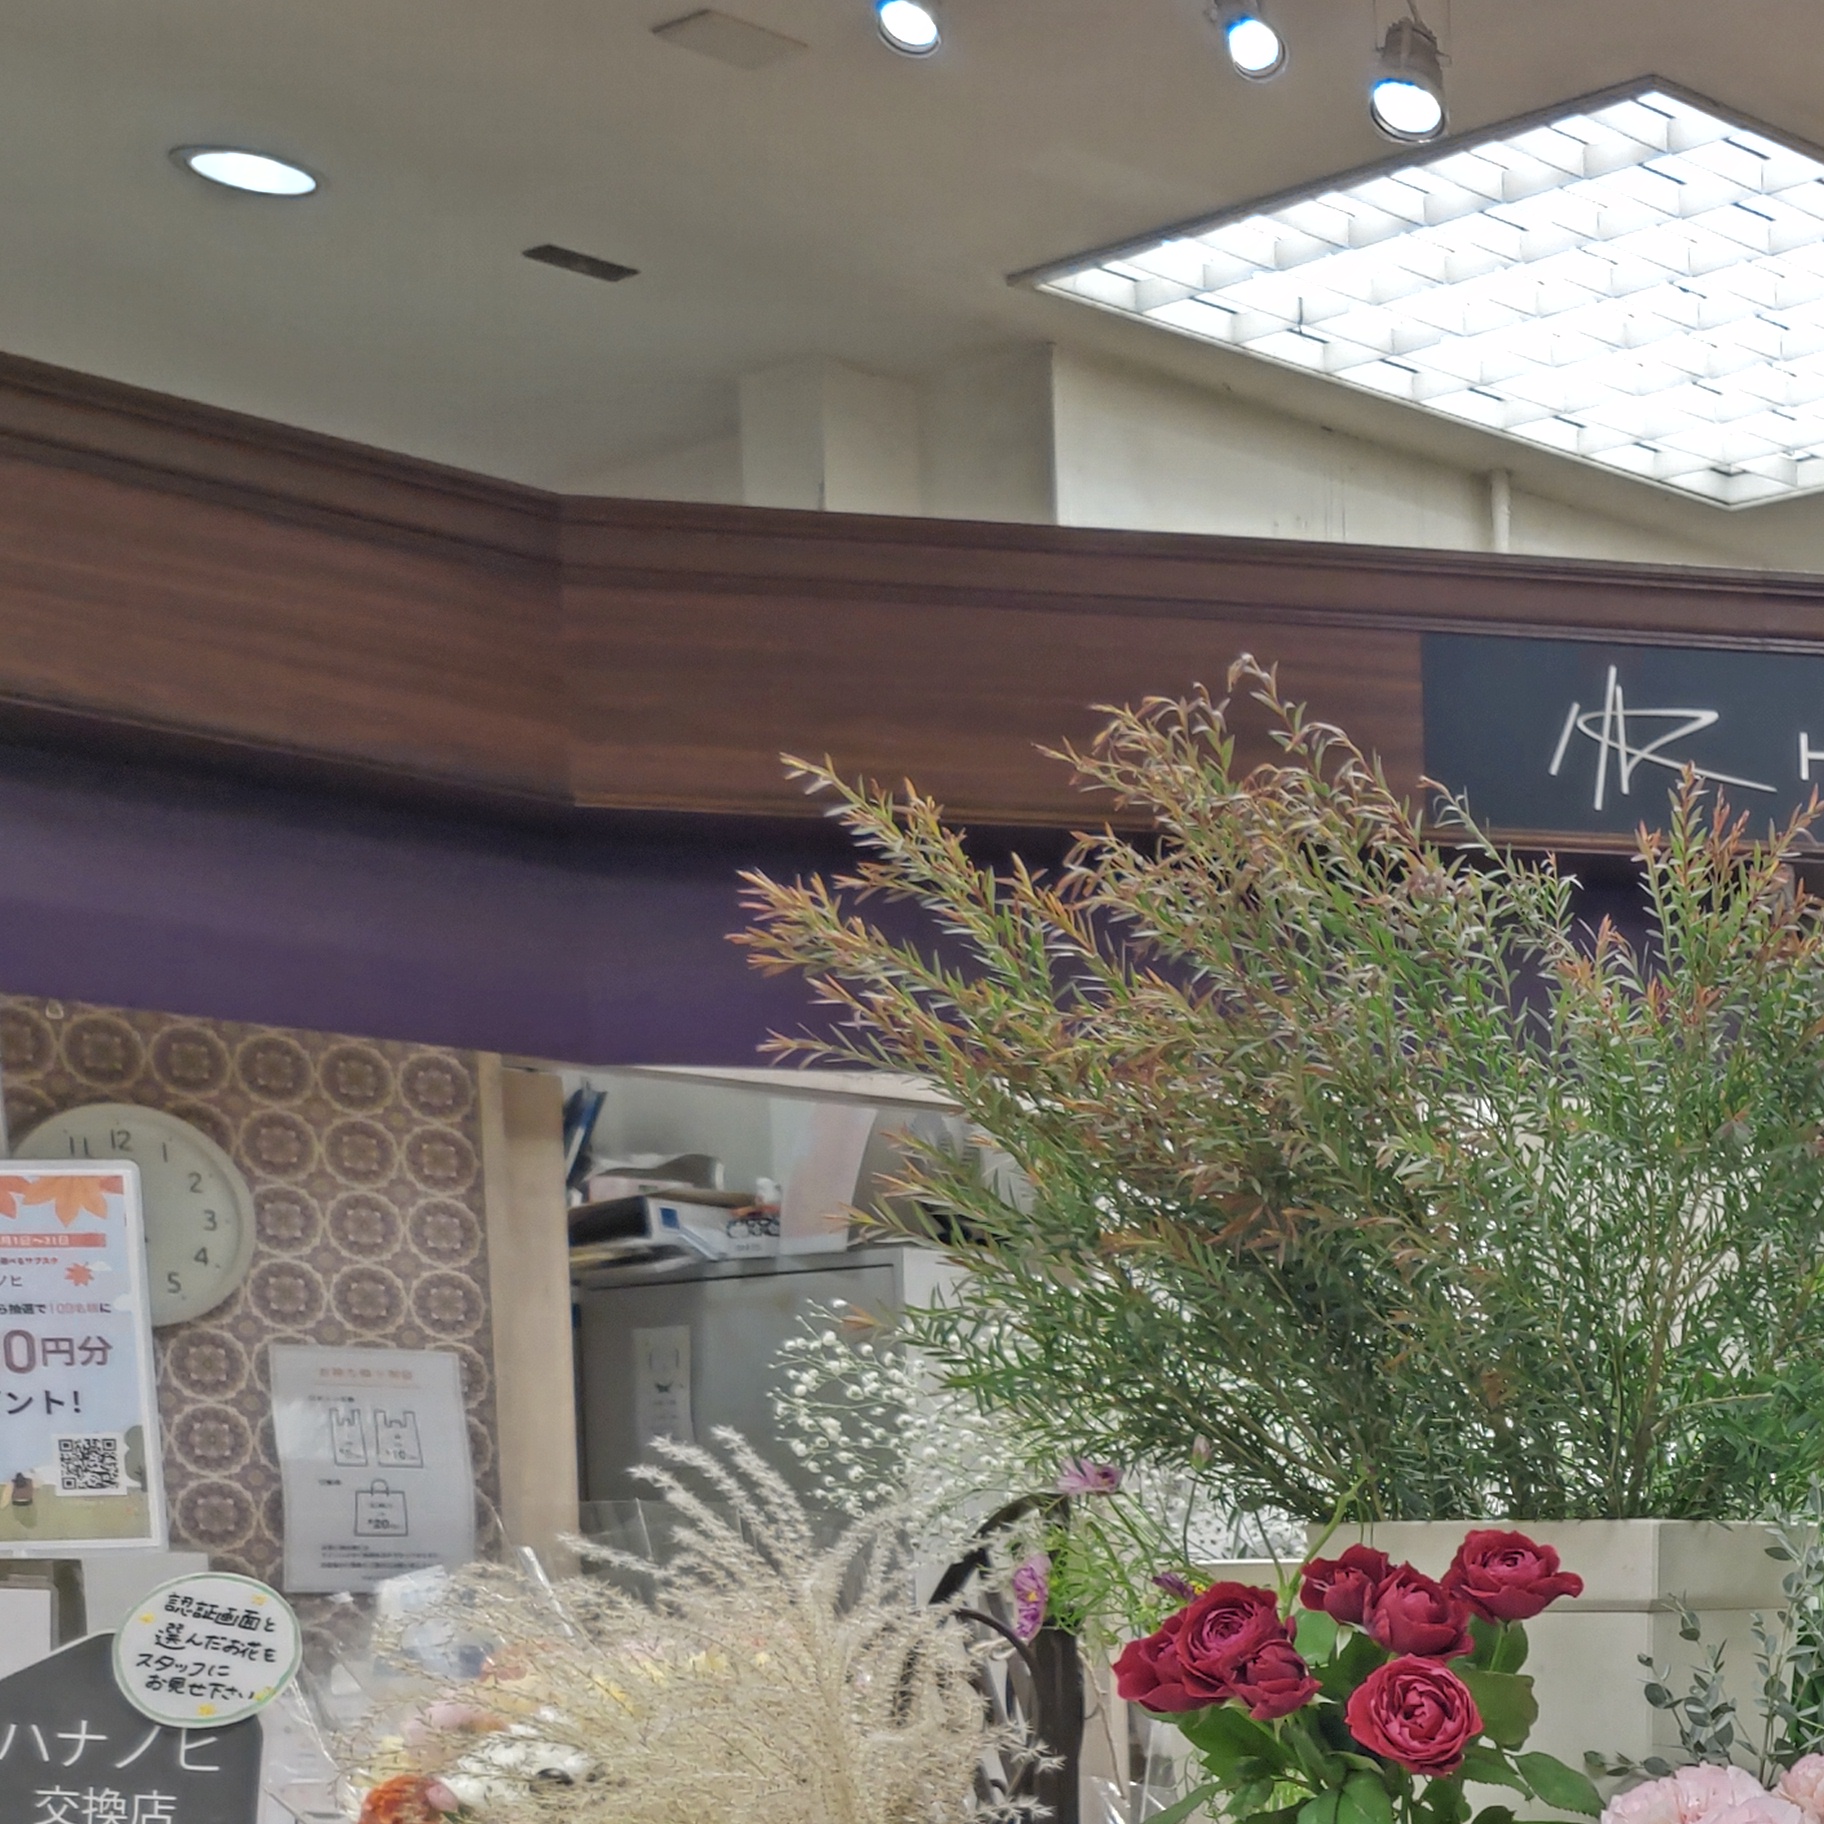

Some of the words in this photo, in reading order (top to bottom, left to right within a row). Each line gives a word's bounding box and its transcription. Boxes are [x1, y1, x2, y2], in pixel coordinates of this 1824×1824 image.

[110, 1129, 132, 1151] 12
[188, 1172, 203, 1194] 2
[203, 1209, 218, 1231] 3
[193, 1247, 209, 1267] 4
[166, 1272, 182, 1294] 5
[164, 1592, 277, 1633] 認証画面と
[154, 1622, 277, 1663] 選んだお花を
[135, 1652, 231, 1678] スタッフに
[145, 1674, 255, 1701] お見せ下さい
[0, 1719, 221, 1772] ハナノヒ
